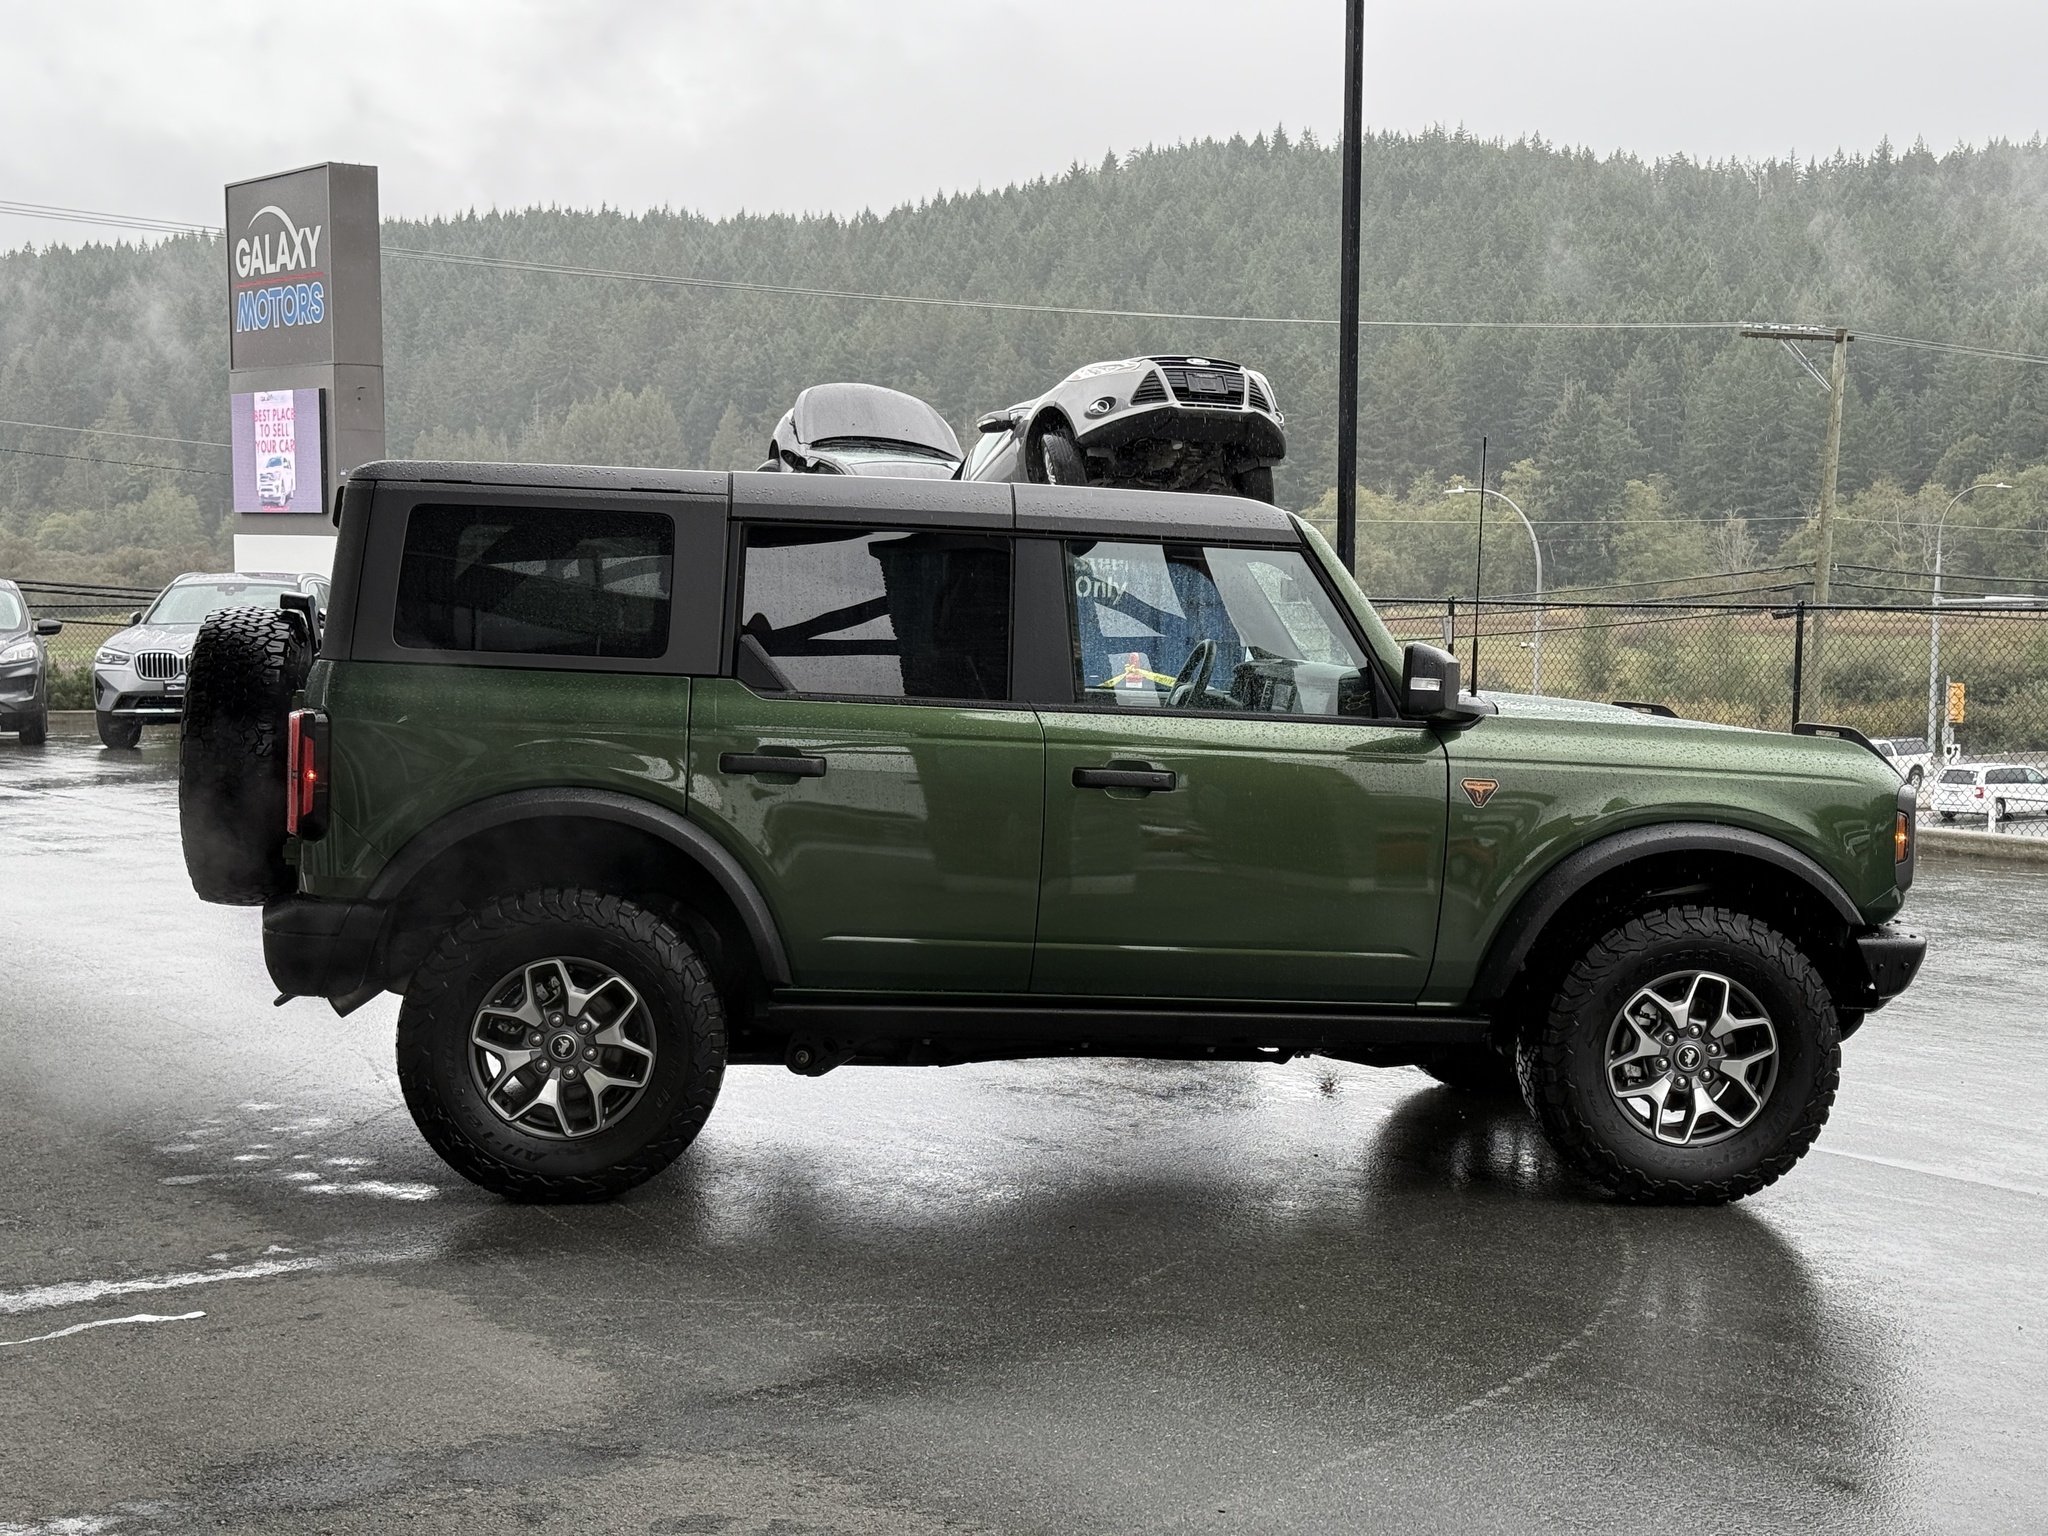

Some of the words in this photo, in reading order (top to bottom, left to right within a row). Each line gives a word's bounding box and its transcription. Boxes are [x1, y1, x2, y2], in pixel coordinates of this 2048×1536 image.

[235, 224, 322, 278] GALAXY
[236, 281, 325, 333] MOTORS
[254, 408, 271, 422] BEST
[272, 407, 296, 421] PLACE
[260, 423, 270, 437] TO
[272, 423, 290, 437] SELL
[255, 439, 277, 454] YOUR
[279, 438, 296, 453] CAR
[1075, 575, 1128, 605] Only
